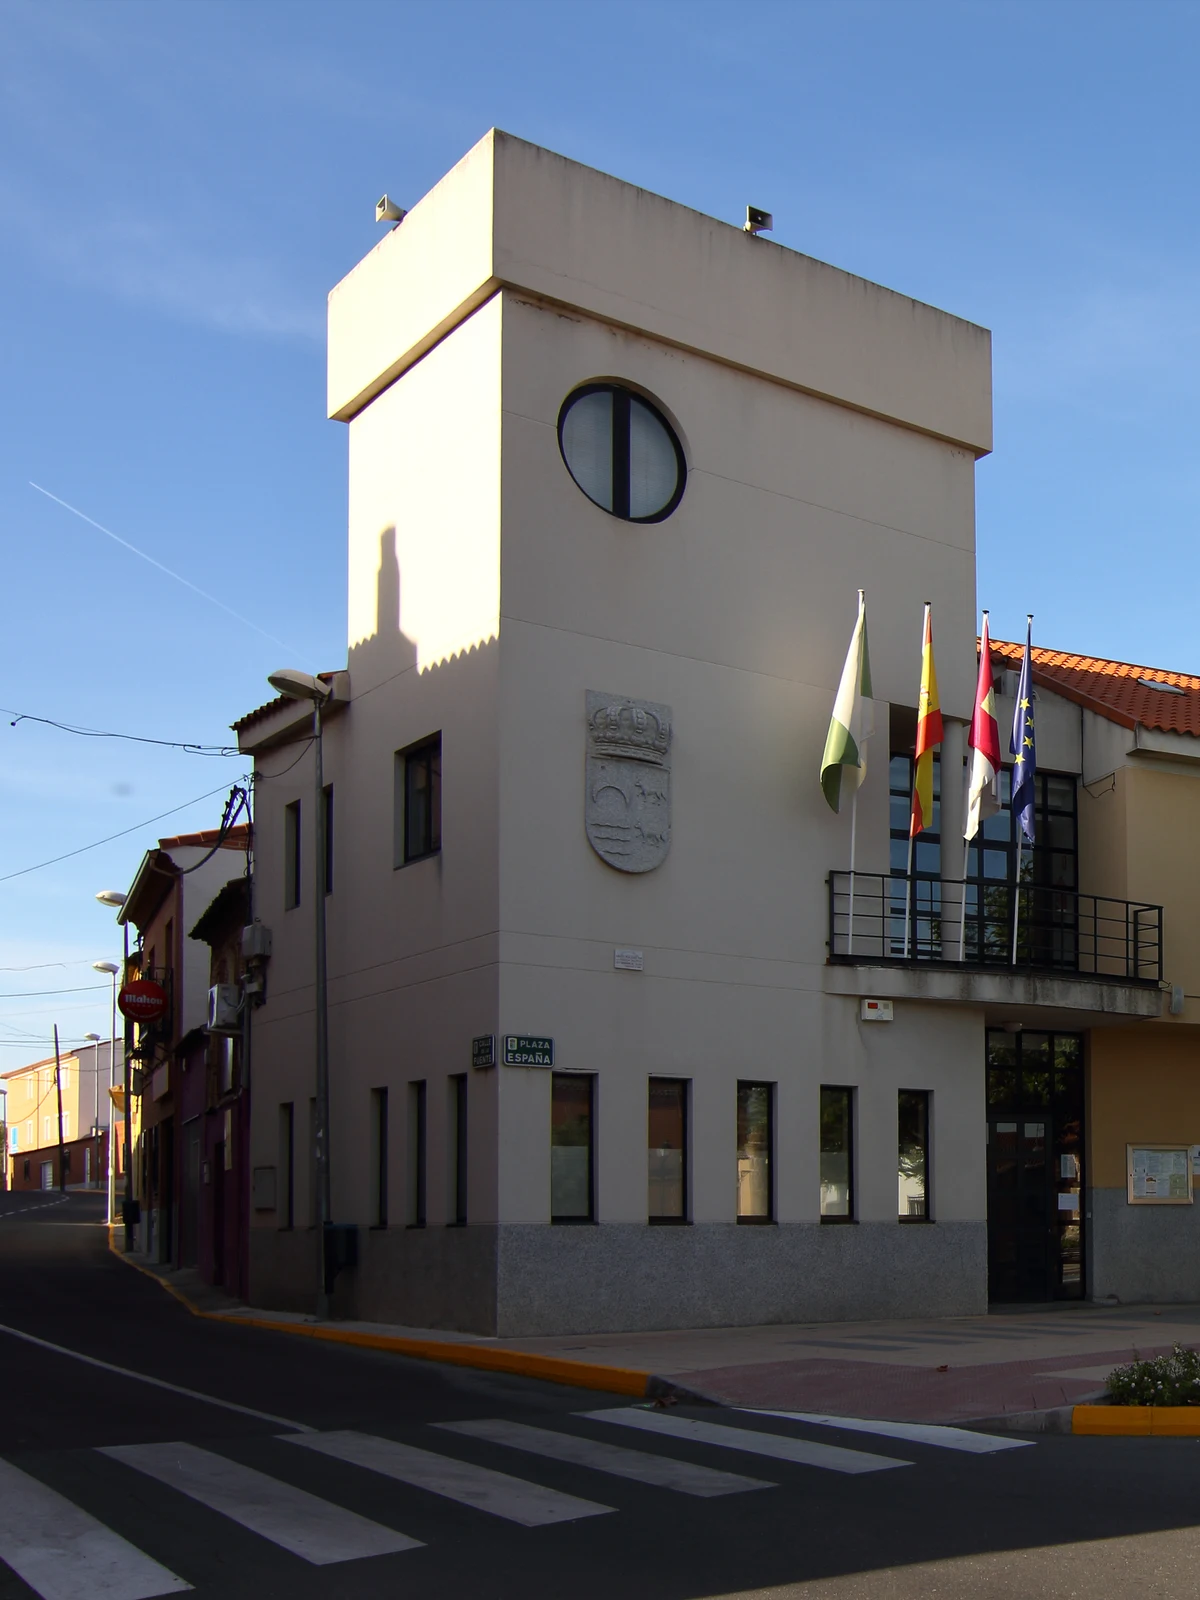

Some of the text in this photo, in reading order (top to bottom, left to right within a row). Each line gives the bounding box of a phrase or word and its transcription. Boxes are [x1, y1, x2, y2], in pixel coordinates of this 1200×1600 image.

[479, 1038, 491, 1047] CALLE
[520, 1040, 550, 1049] PLAZA
[474, 1054, 492, 1065] FUENTE
[507, 1052, 551, 1064] ESPAÑA
